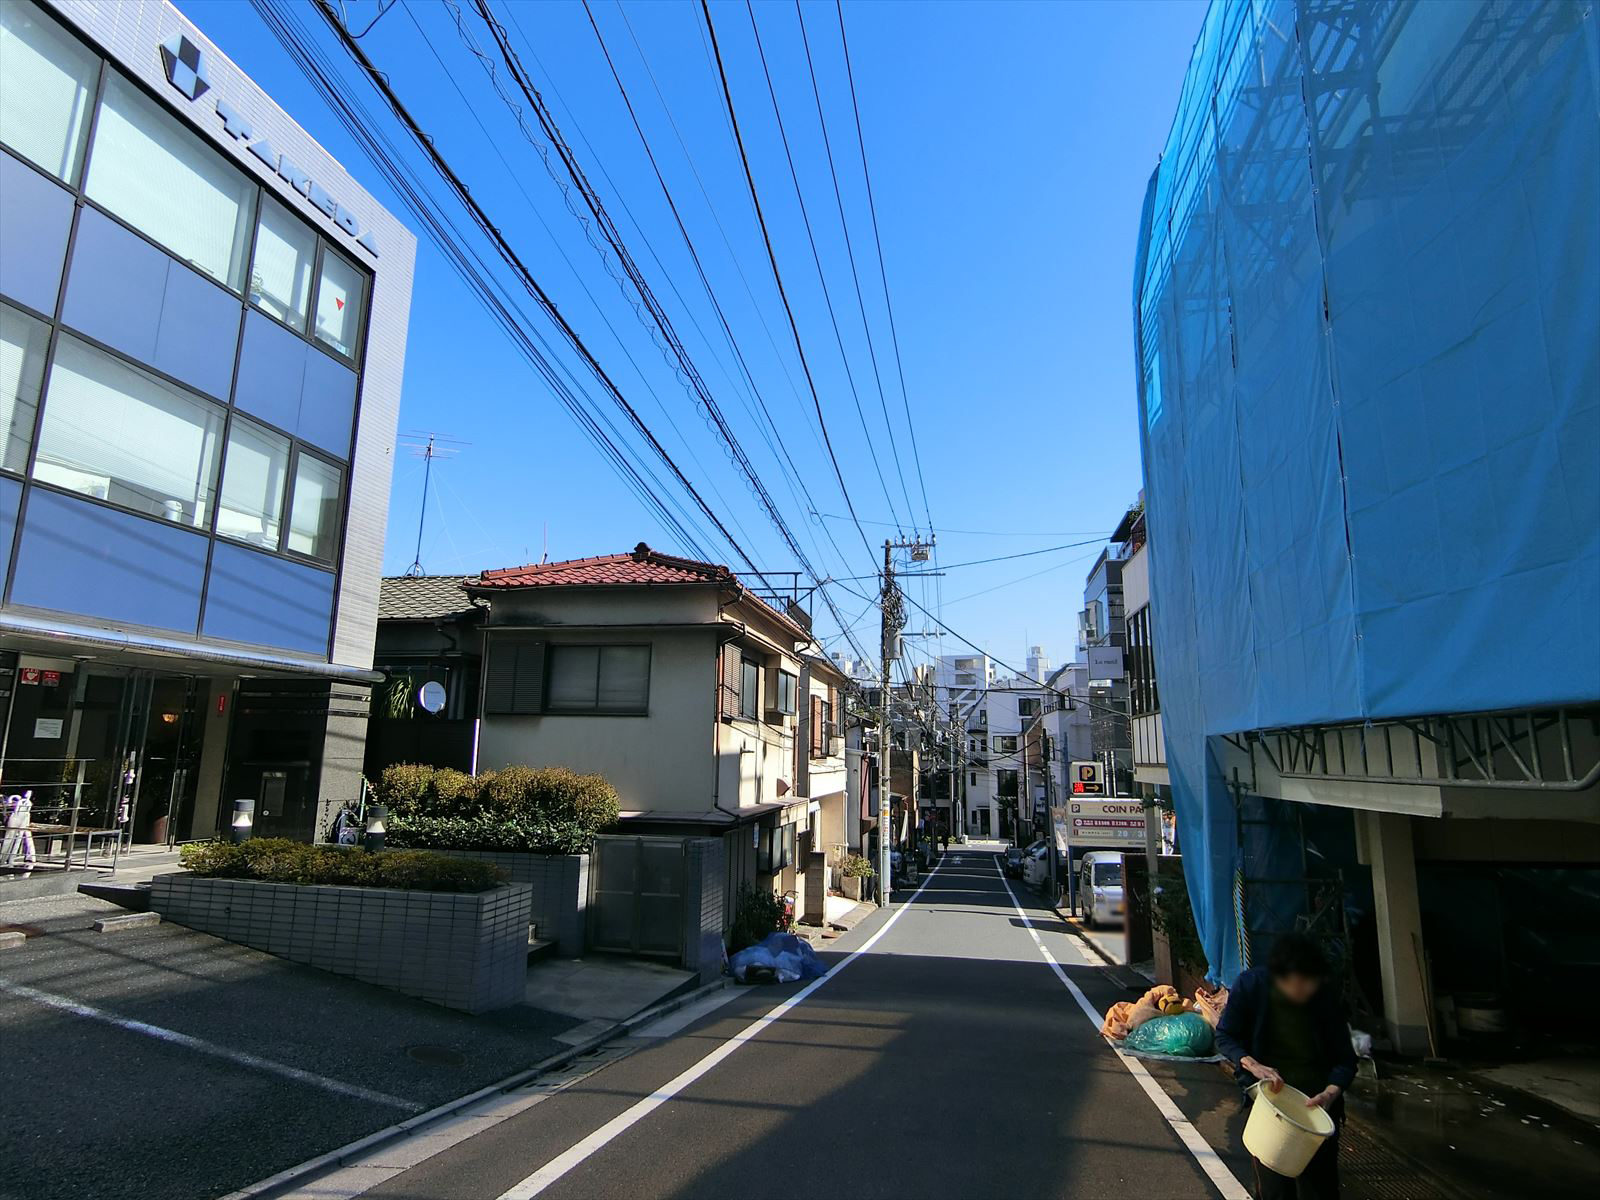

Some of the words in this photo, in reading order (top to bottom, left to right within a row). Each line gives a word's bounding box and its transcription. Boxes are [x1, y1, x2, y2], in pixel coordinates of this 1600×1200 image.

[215, 98, 379, 259] TAKEDA
[1081, 767, 1094, 780] P
[1102, 805, 1127, 813] COIN
[1129, 805, 1145, 813] PA
